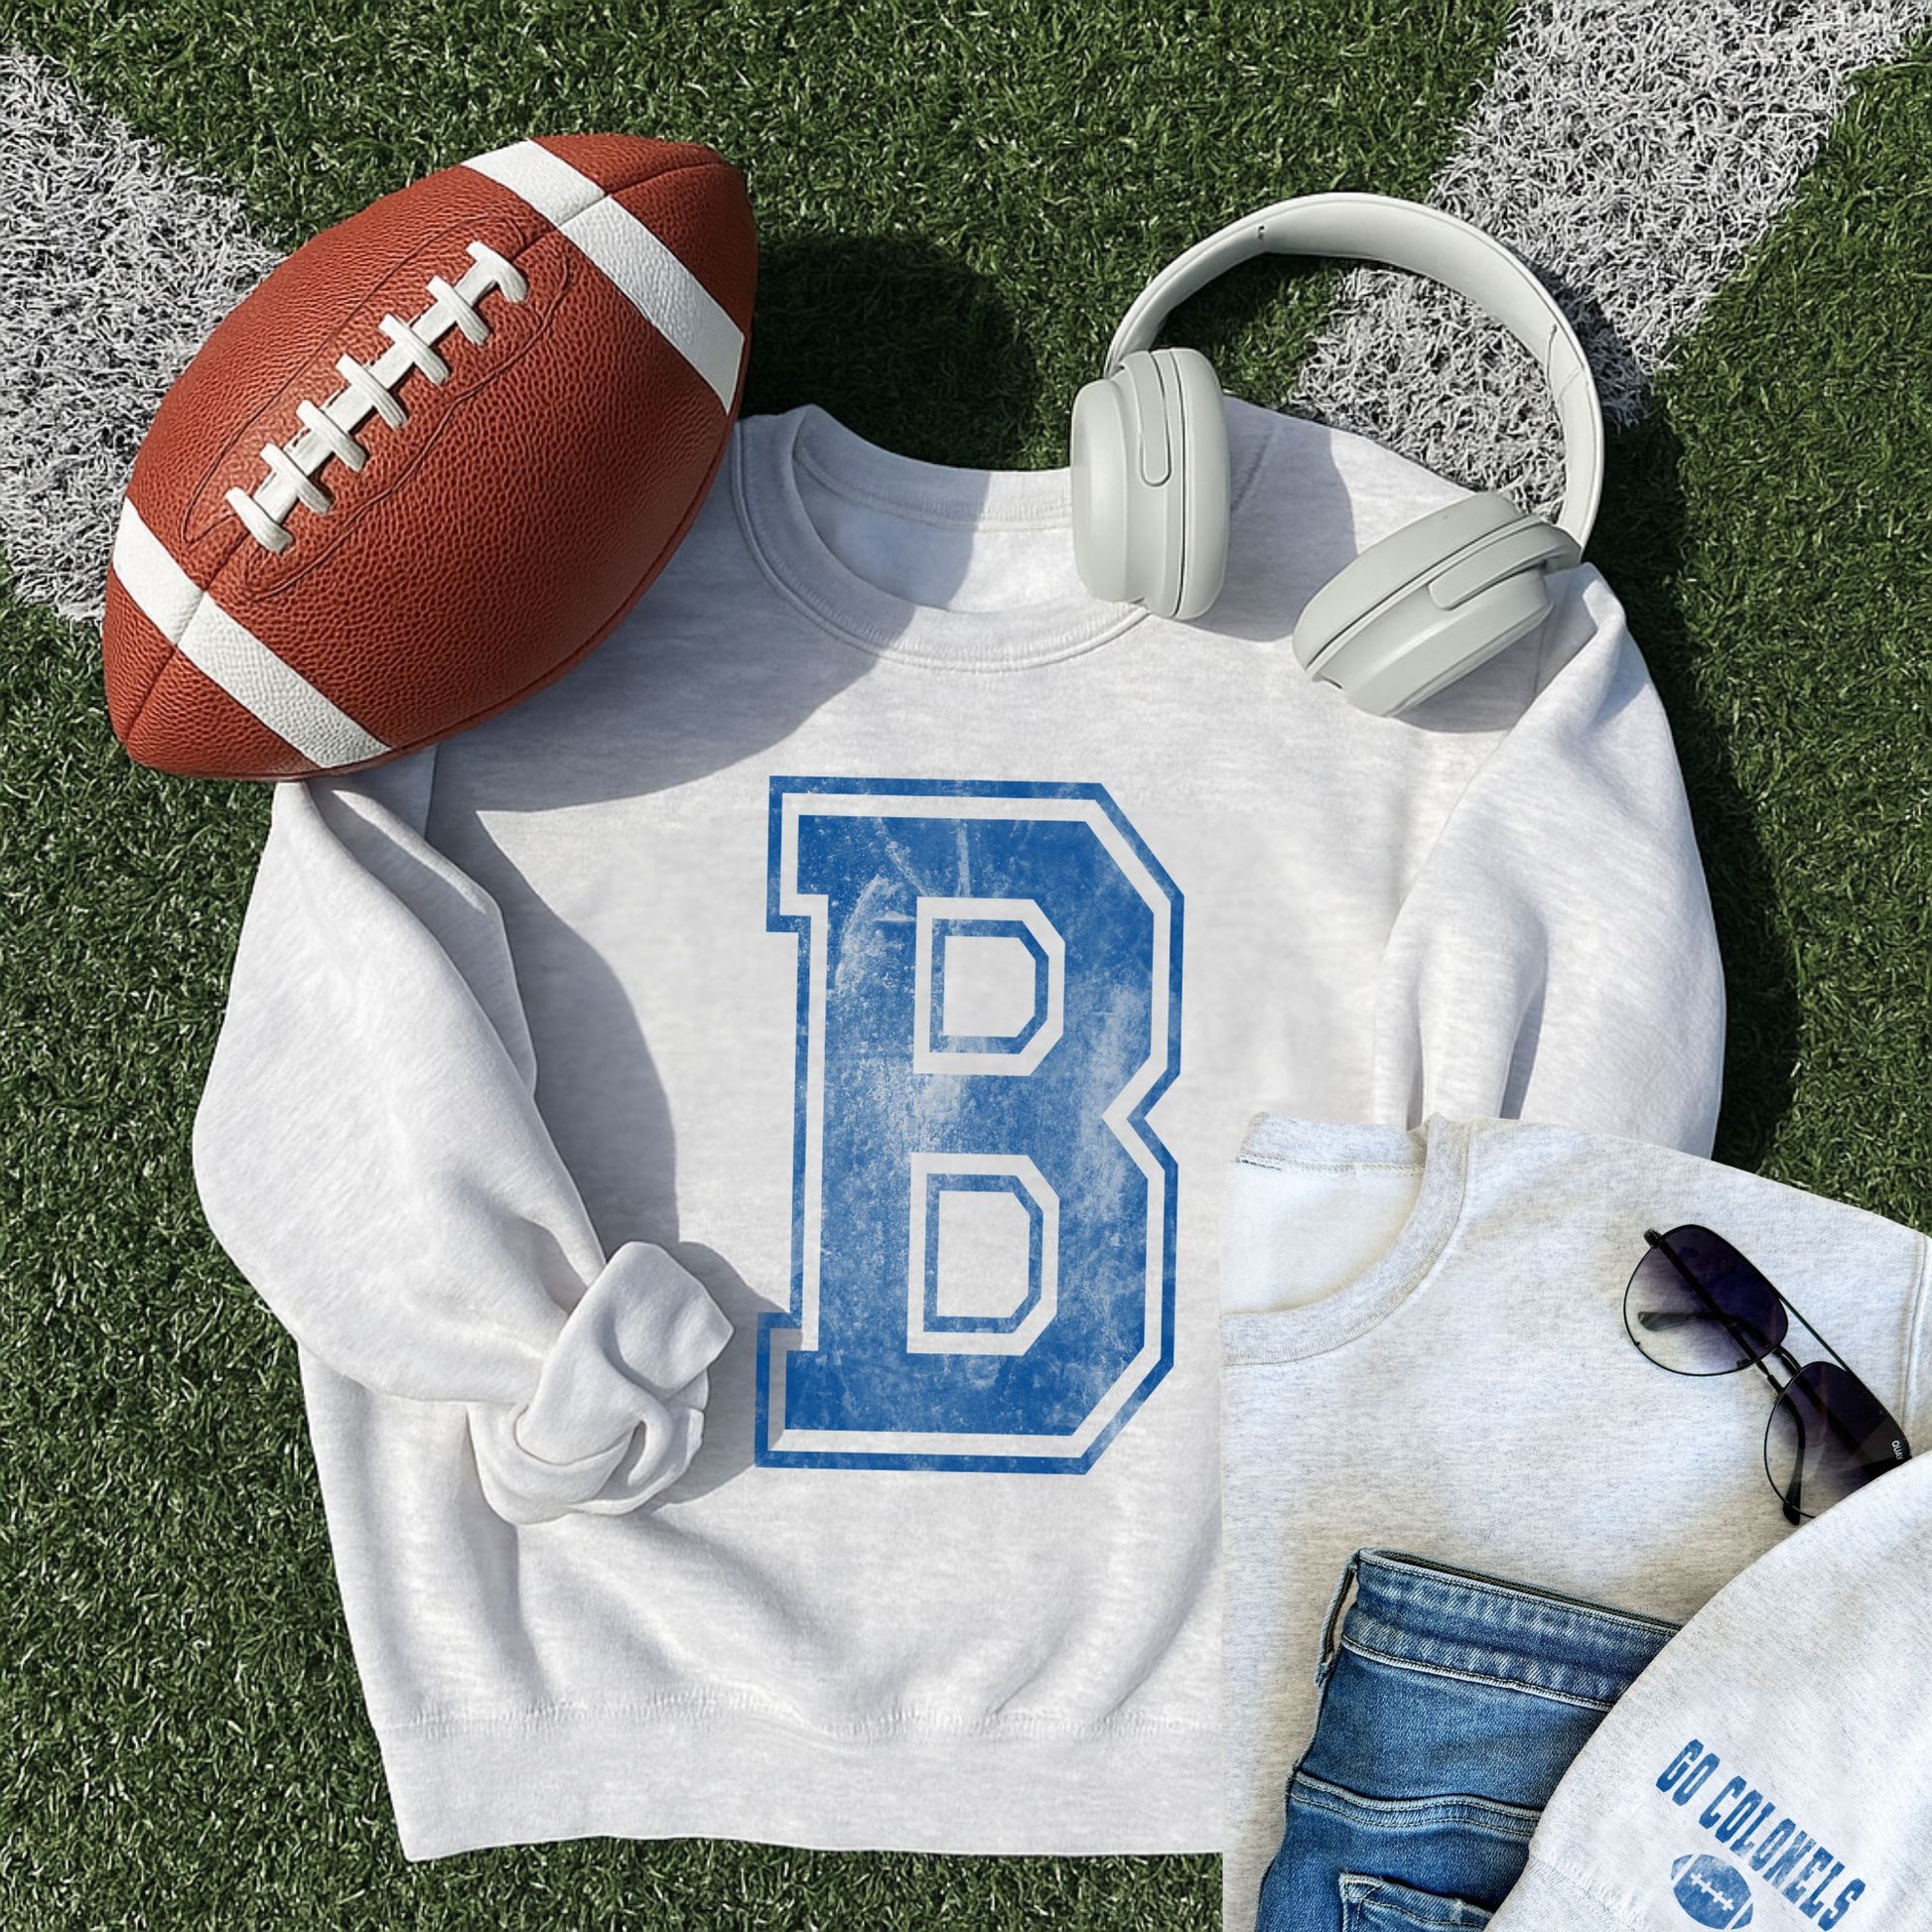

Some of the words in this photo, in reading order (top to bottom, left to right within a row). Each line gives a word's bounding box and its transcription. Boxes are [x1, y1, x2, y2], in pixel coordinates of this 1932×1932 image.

[755, 775, 1185, 1476] B
[1891, 1440, 1905, 1460] QUAY
[1655, 1738, 1721, 1806] GO
[1698, 1775, 1866, 1932] COLONELS
